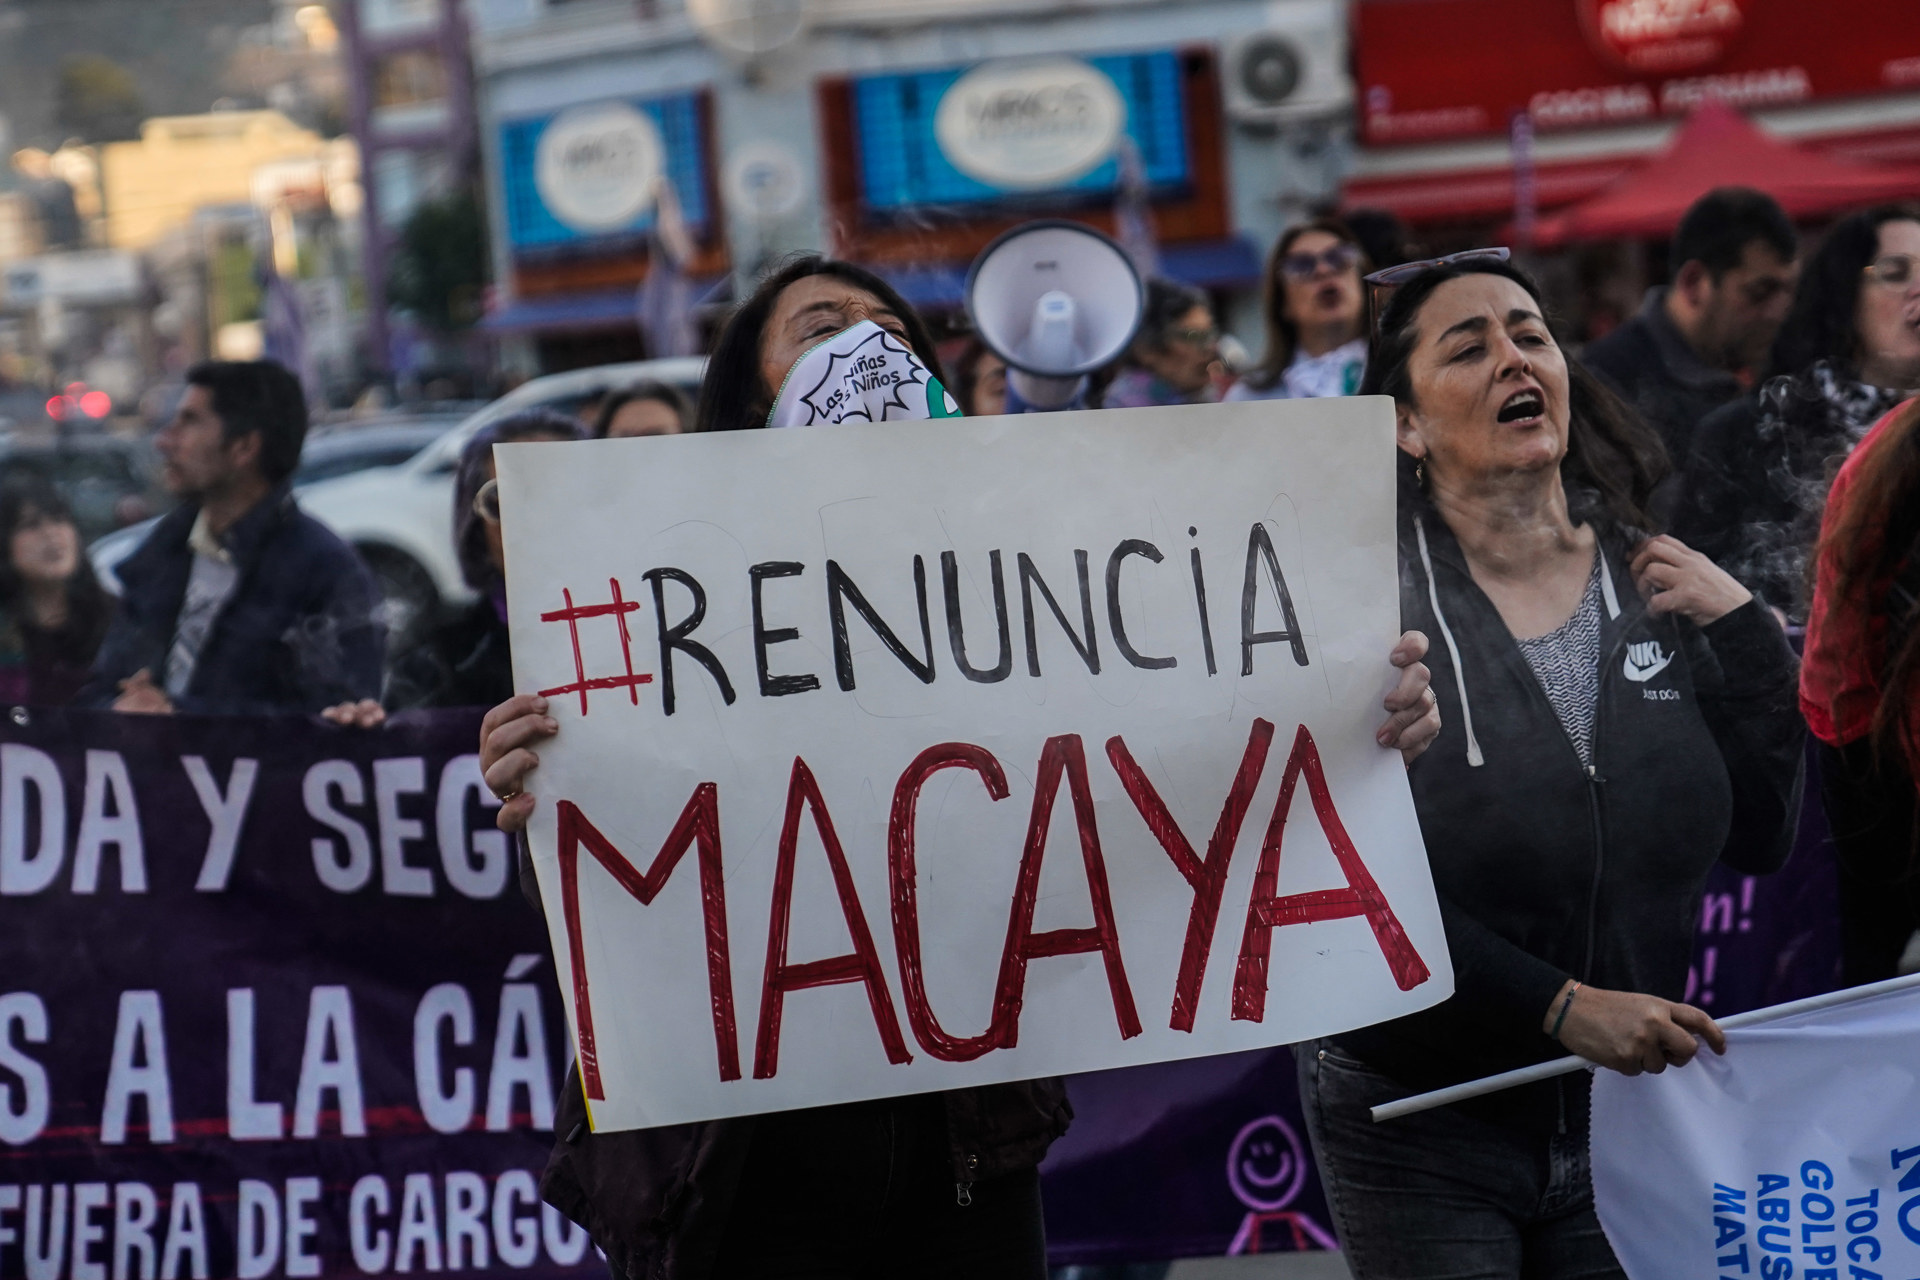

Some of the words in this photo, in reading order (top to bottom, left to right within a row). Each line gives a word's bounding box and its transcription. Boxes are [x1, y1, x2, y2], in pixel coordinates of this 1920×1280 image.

[815, 388, 844, 419] Las
[851, 371, 901, 395] Niños
[538, 522, 1310, 716] #RENUNCIA
[0, 742, 149, 895] DA
[181, 755, 258, 891] Y
[556, 717, 1432, 1101] MACAYA
[0, 991, 50, 1145] S
[100, 990, 175, 1144] A
[226, 985, 367, 1139] LA
[413, 953, 575, 1134] CÁ
[237, 1177, 321, 1279] DE
[348, 1169, 608, 1274] CARGO
[1713, 1182, 1750, 1280] MAT
[1757, 1174, 1793, 1280] ABUS
